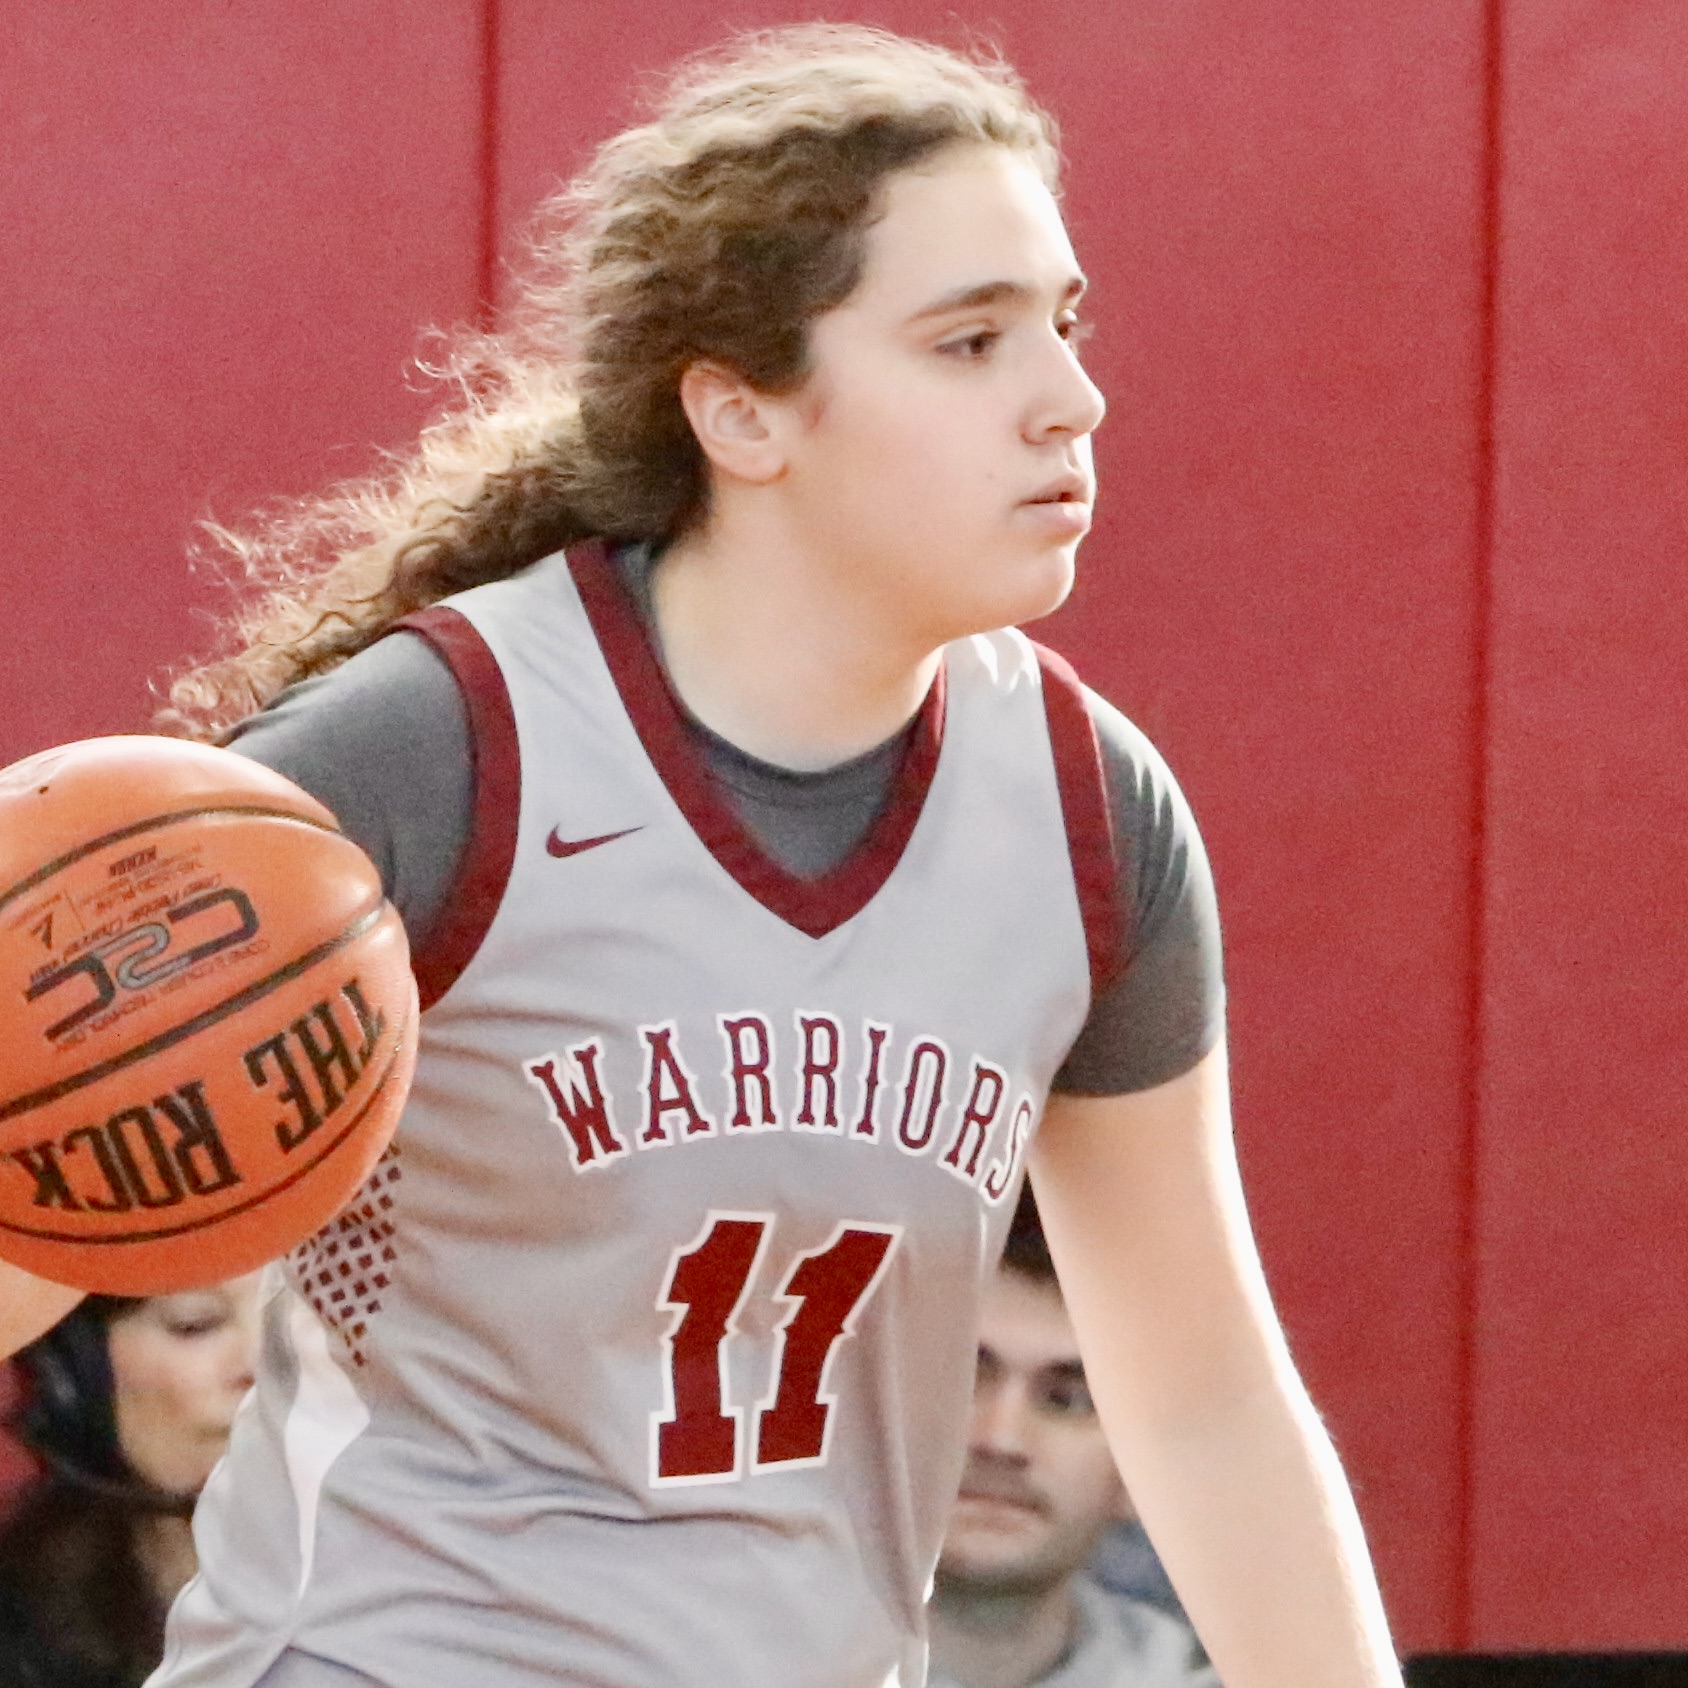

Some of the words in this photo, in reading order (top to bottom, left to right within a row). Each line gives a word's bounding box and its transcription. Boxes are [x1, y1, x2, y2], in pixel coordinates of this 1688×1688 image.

[4, 1079, 242, 1214] ROCK
[242, 977, 386, 1156] THE
[524, 1010, 1034, 1204] WARRIORS
[650, 1211, 904, 1487] 11
